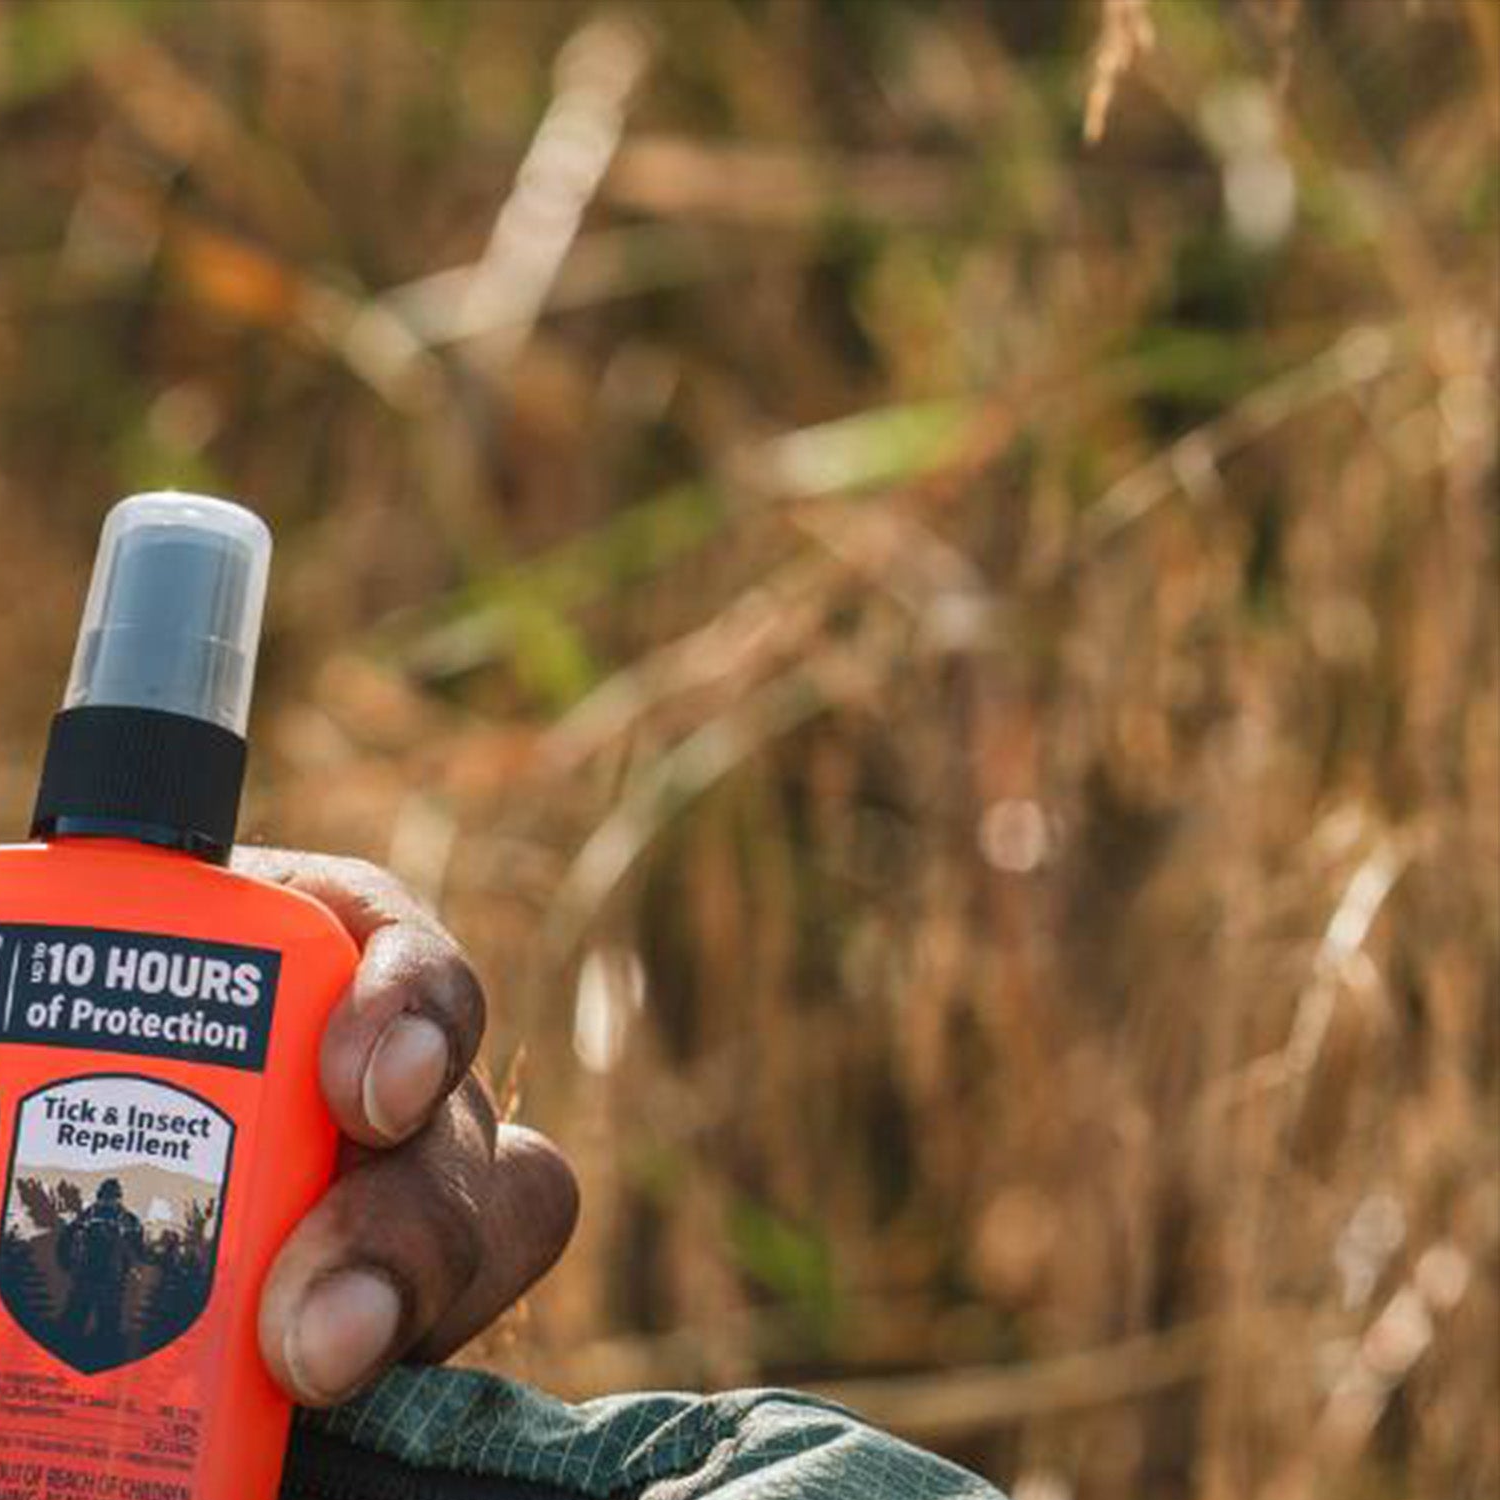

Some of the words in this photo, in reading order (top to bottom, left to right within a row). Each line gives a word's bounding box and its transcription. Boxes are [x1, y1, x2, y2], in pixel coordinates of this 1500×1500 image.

[48, 942, 95, 985] 10
[105, 947, 262, 1006] HOURS
[26, 996, 66, 1028] of
[71, 1001, 249, 1052] Protection
[44, 1097, 97, 1123] Tick
[102, 1107, 119, 1126] &
[128, 1106, 211, 1138] Insect
[57, 1123, 191, 1160] Repellent
